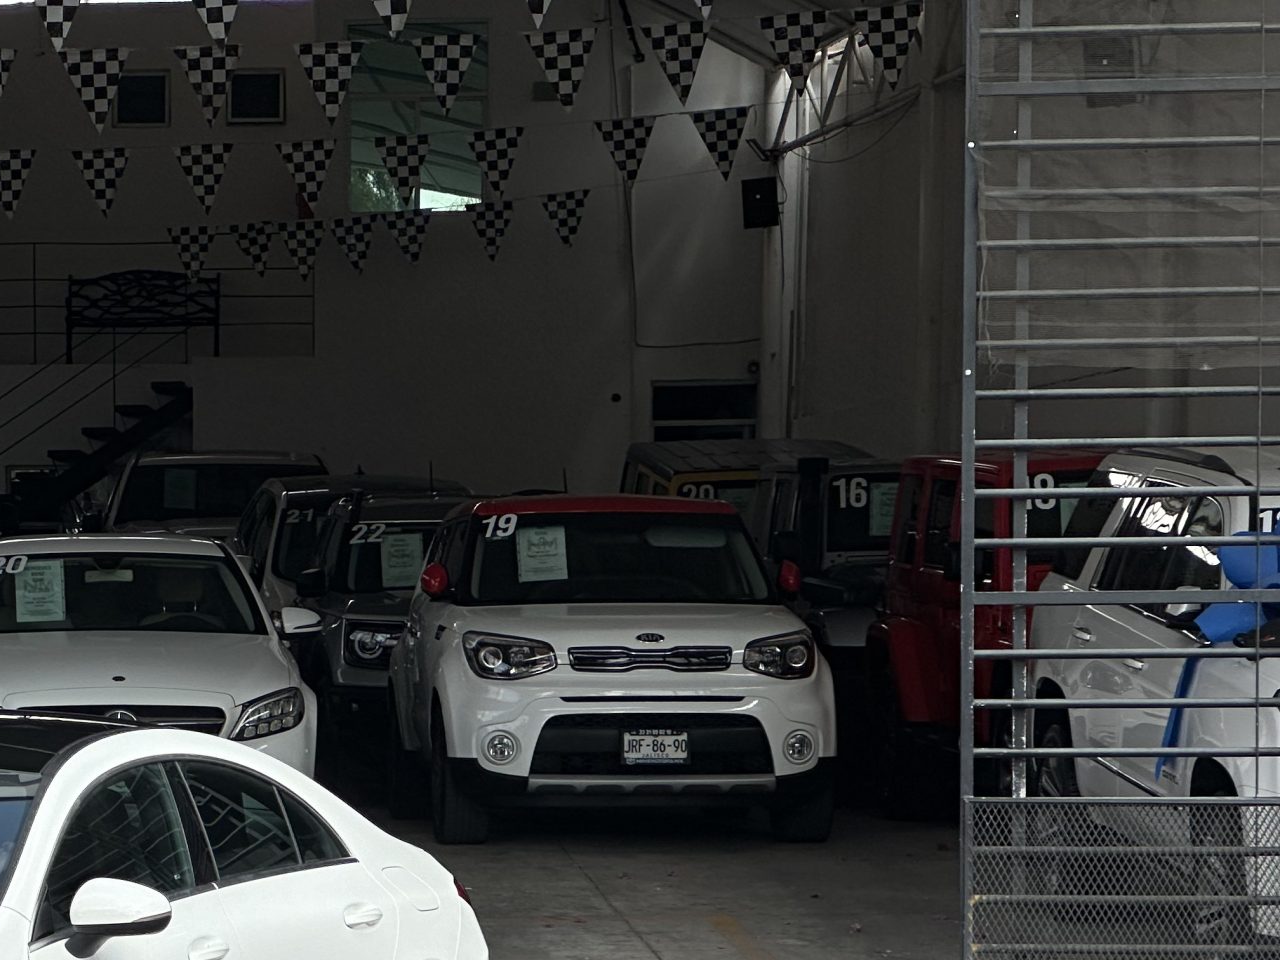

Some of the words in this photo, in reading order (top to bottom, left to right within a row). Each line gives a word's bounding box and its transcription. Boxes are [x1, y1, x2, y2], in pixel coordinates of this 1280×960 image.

[831, 477, 868, 509] 16
[285, 508, 315, 524] 21
[481, 513, 518, 538] 19
[349, 523, 387, 545] 22
[625, 739, 687, 753] JRF-86-90
